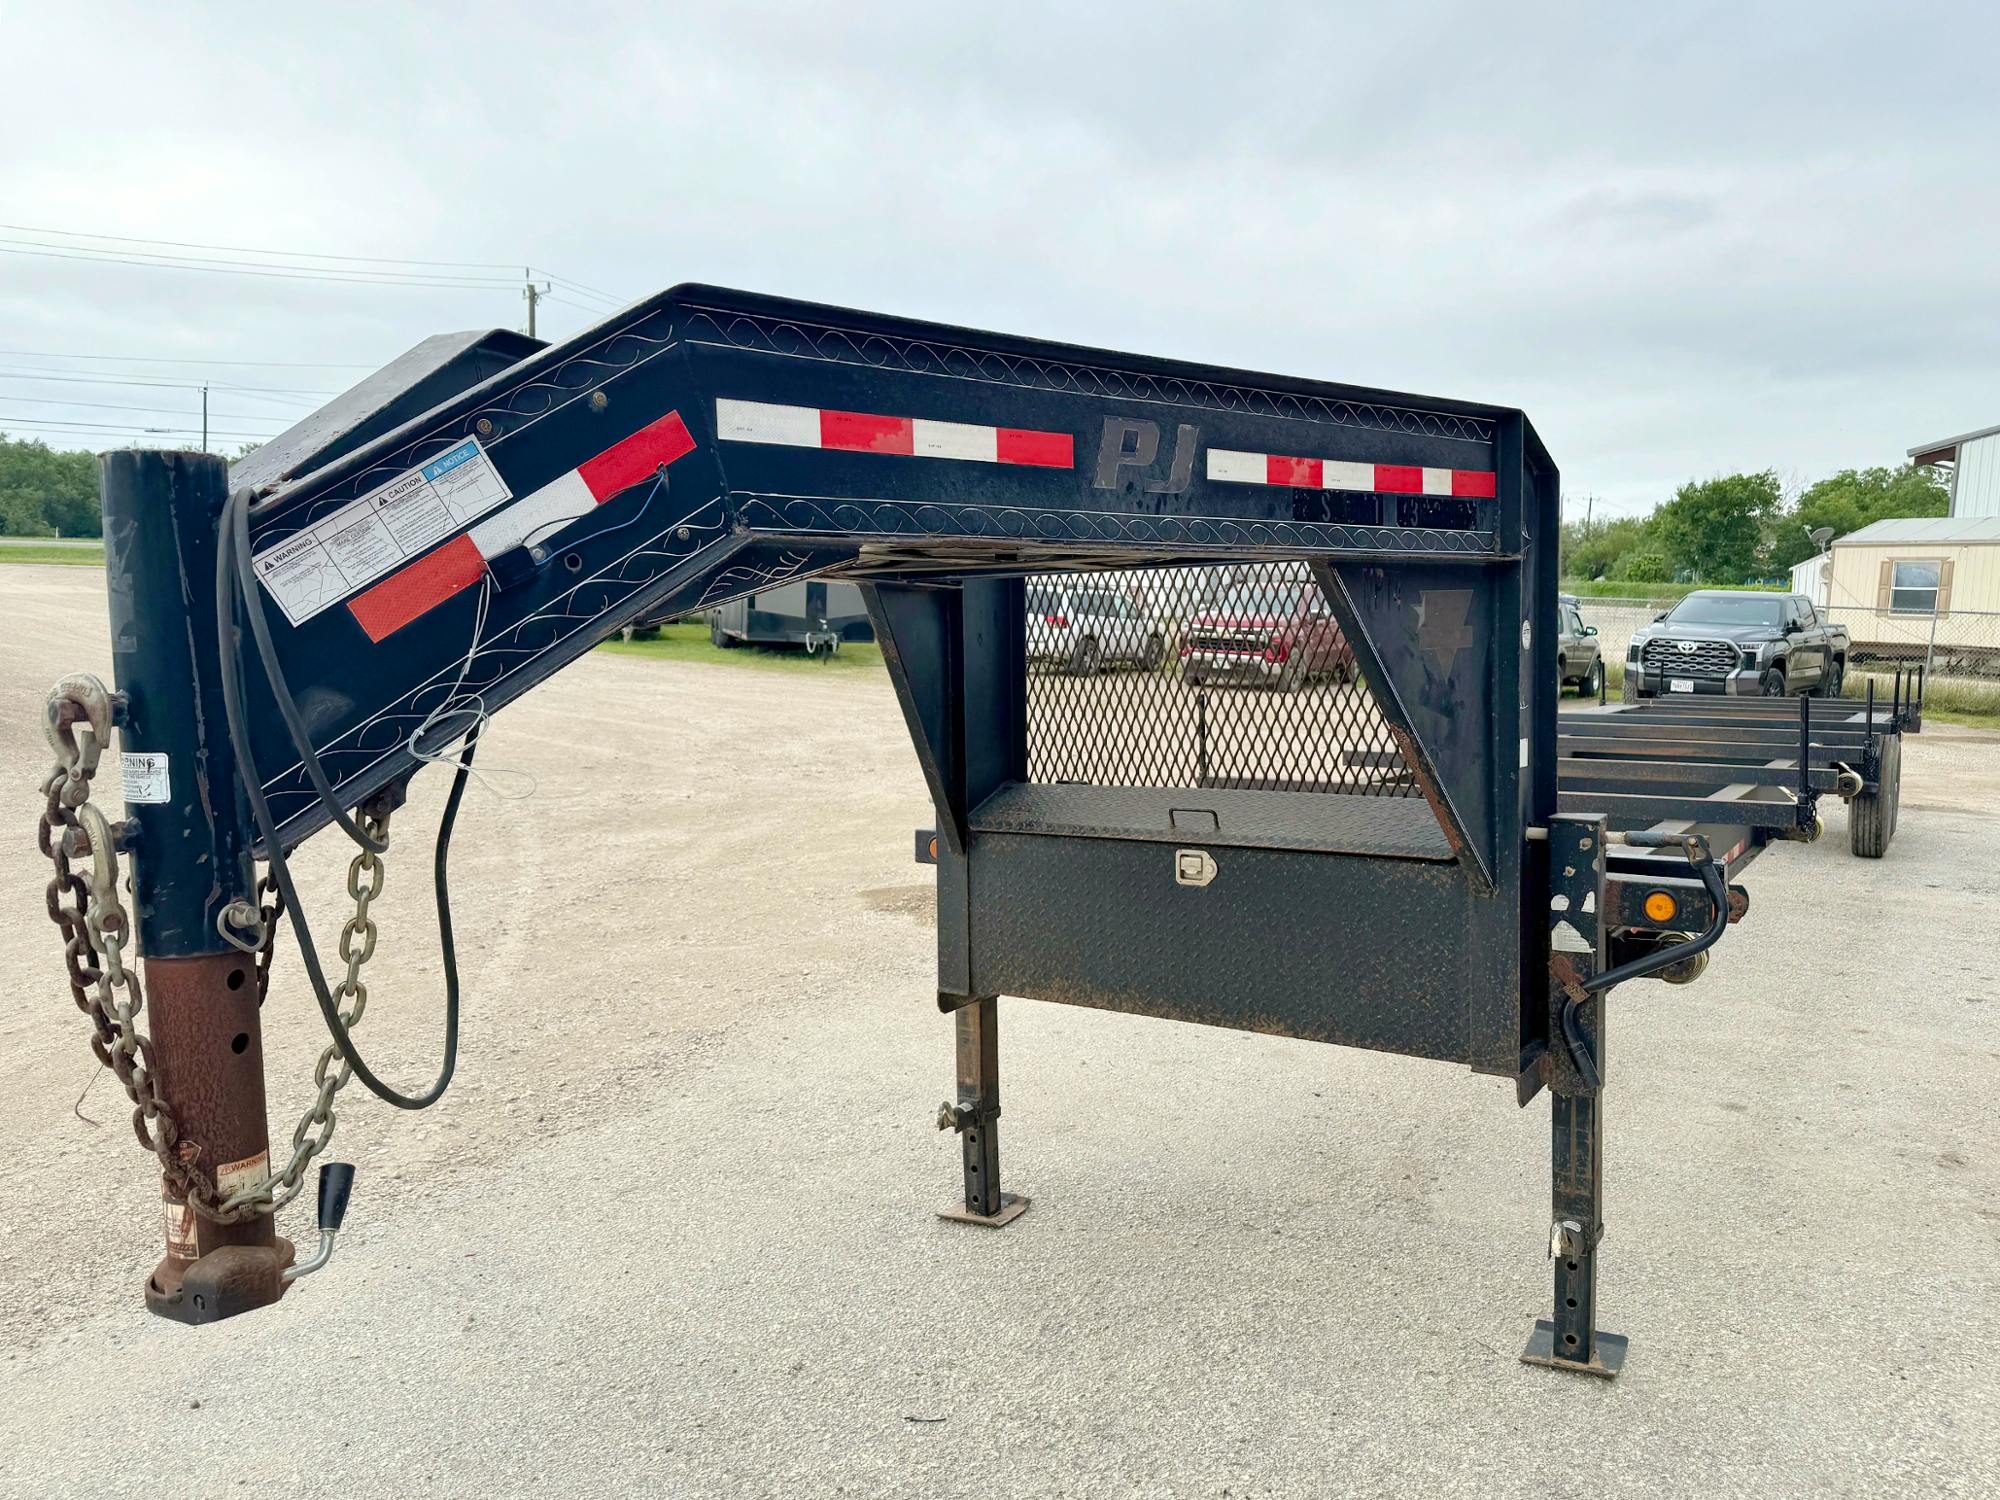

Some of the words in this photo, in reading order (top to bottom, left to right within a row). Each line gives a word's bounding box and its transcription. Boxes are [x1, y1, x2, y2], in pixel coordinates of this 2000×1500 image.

[443, 449, 470, 467] NOTICE
[1093, 414, 1200, 494] PJ
[388, 476, 422, 499] CAUTION
[273, 538, 313, 563] WARNING
